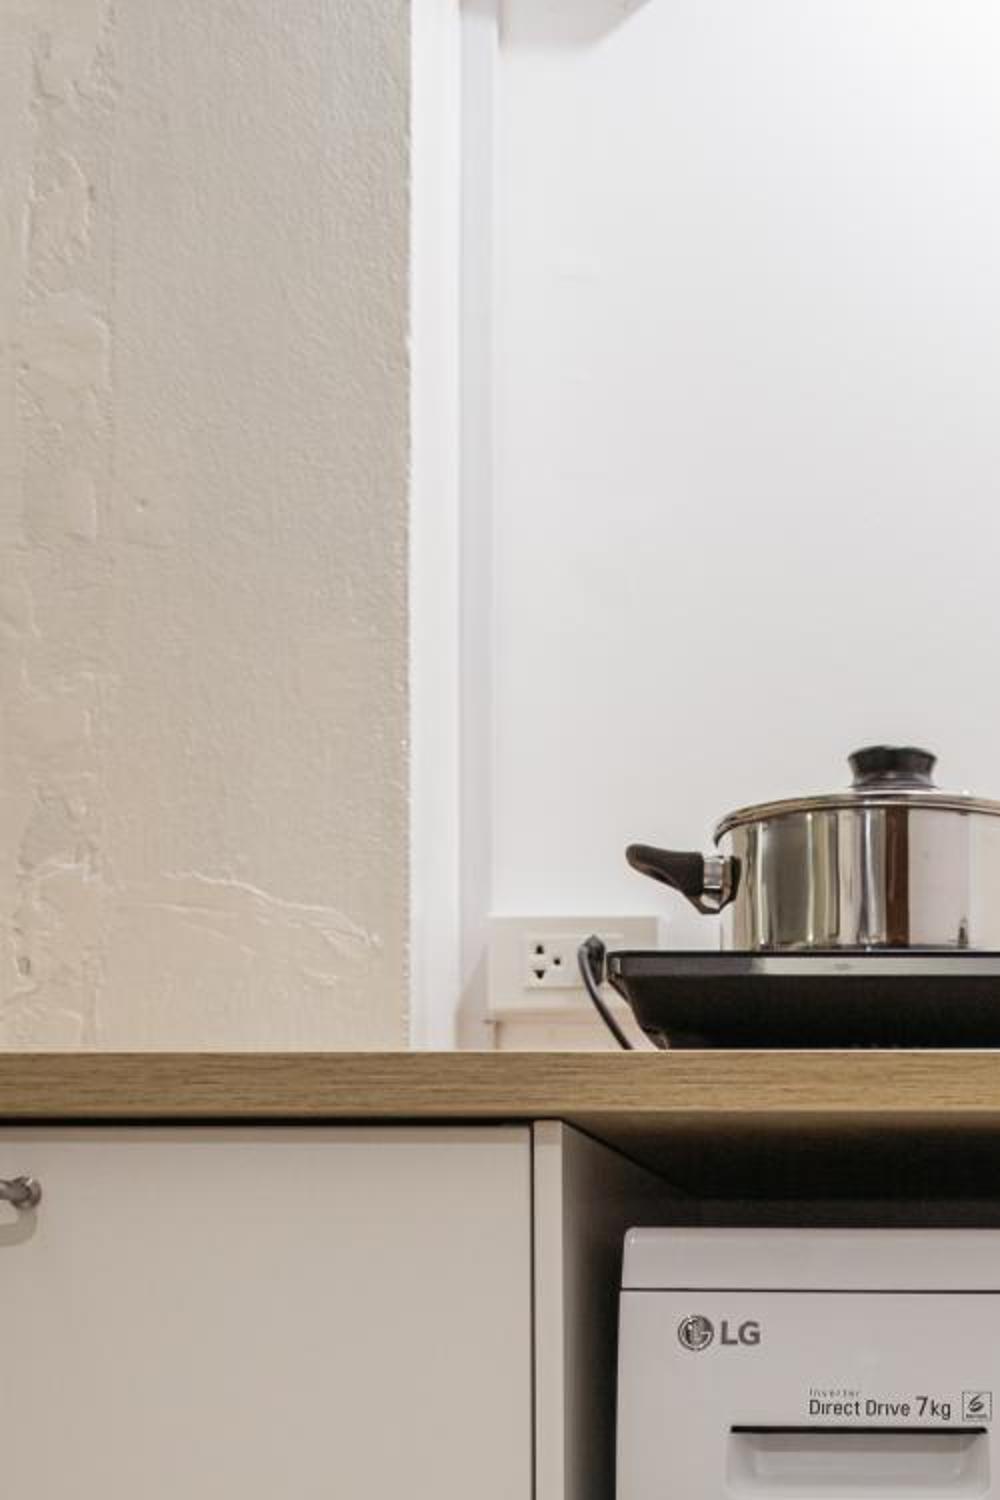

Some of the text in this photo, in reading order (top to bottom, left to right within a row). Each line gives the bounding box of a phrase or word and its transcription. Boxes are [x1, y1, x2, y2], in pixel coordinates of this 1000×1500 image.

[720, 1320, 761, 1345] LG
[809, 1399, 860, 1417] Direct
[865, 1399, 911, 1417] Drive
